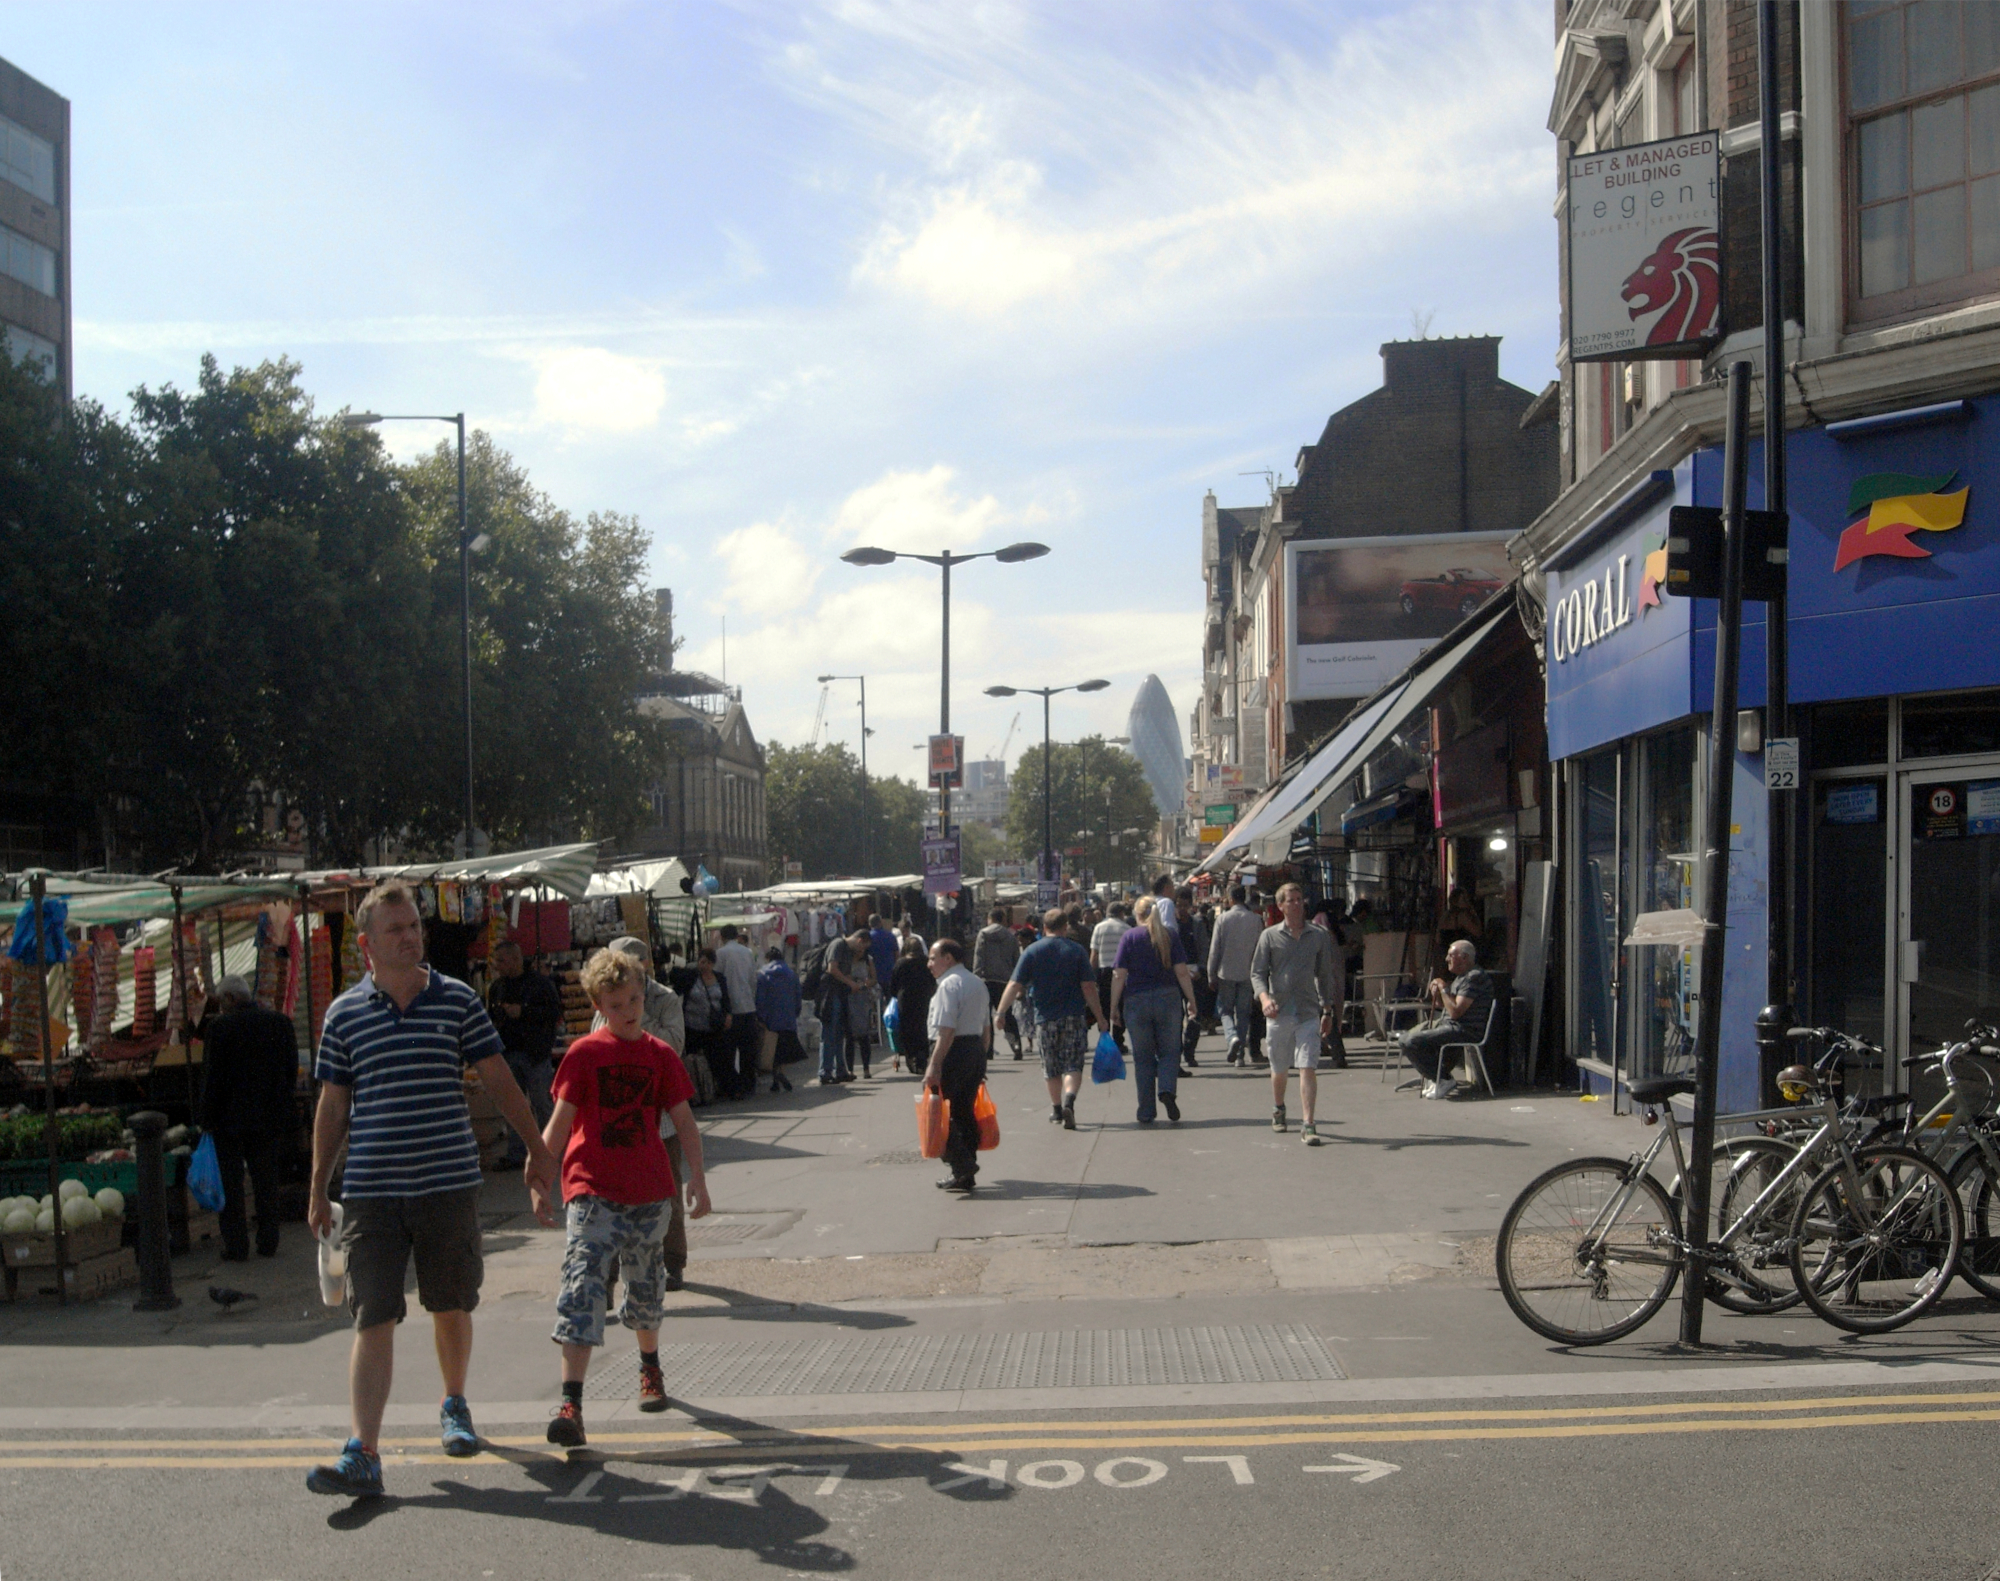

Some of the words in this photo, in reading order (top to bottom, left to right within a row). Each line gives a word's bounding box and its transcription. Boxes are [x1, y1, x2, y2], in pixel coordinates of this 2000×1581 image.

[1574, 160, 1604, 178] LET
[1609, 157, 1621, 171] &
[1626, 140, 1712, 168] MANAGED
[1604, 163, 1681, 189] BUILDING
[1572, 178, 1717, 222] regent
[1573, 221, 1640, 238] PROPERTY
[1650, 209, 1717, 226] SERVICES
[1573, 336, 1588, 345] 020
[1591, 332, 1612, 342] 7790
[1614, 328, 1635, 339] 9977
[1553, 554, 1630, 661] CORAL
[1770, 771, 1794, 787] 22
[1934, 795, 1951, 807] 18
[932, 1454, 1255, 1490] LOOK
